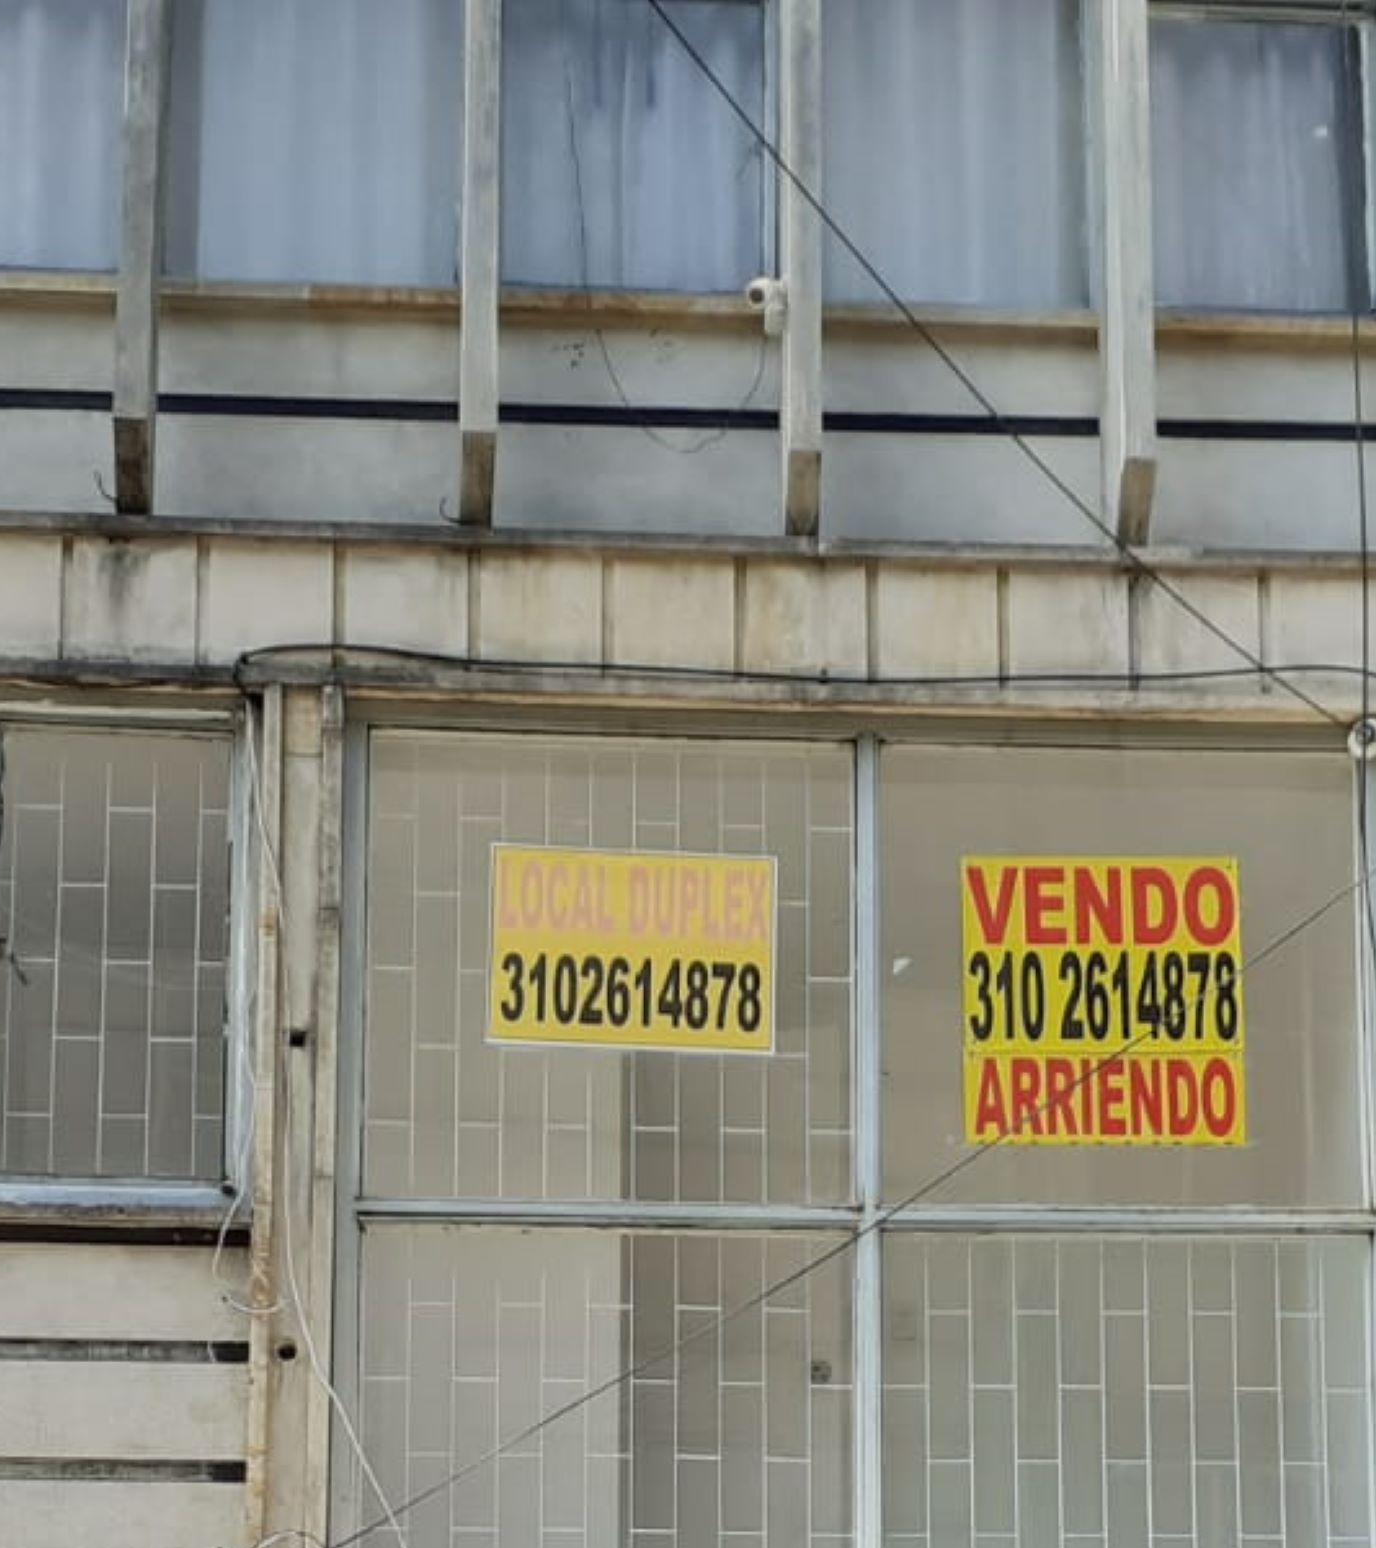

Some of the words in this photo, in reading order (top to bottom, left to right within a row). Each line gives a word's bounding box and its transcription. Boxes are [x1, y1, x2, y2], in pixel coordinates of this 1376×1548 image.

[498, 858, 616, 936] LOCAL
[627, 863, 769, 944] DUPLEX
[967, 865, 1235, 946] VENDO
[500, 952, 762, 1032] 3102614878
[969, 951, 1045, 1041] 310
[1058, 951, 1238, 1041] 2614878
[975, 1056, 1236, 1137] ARRIENDO
